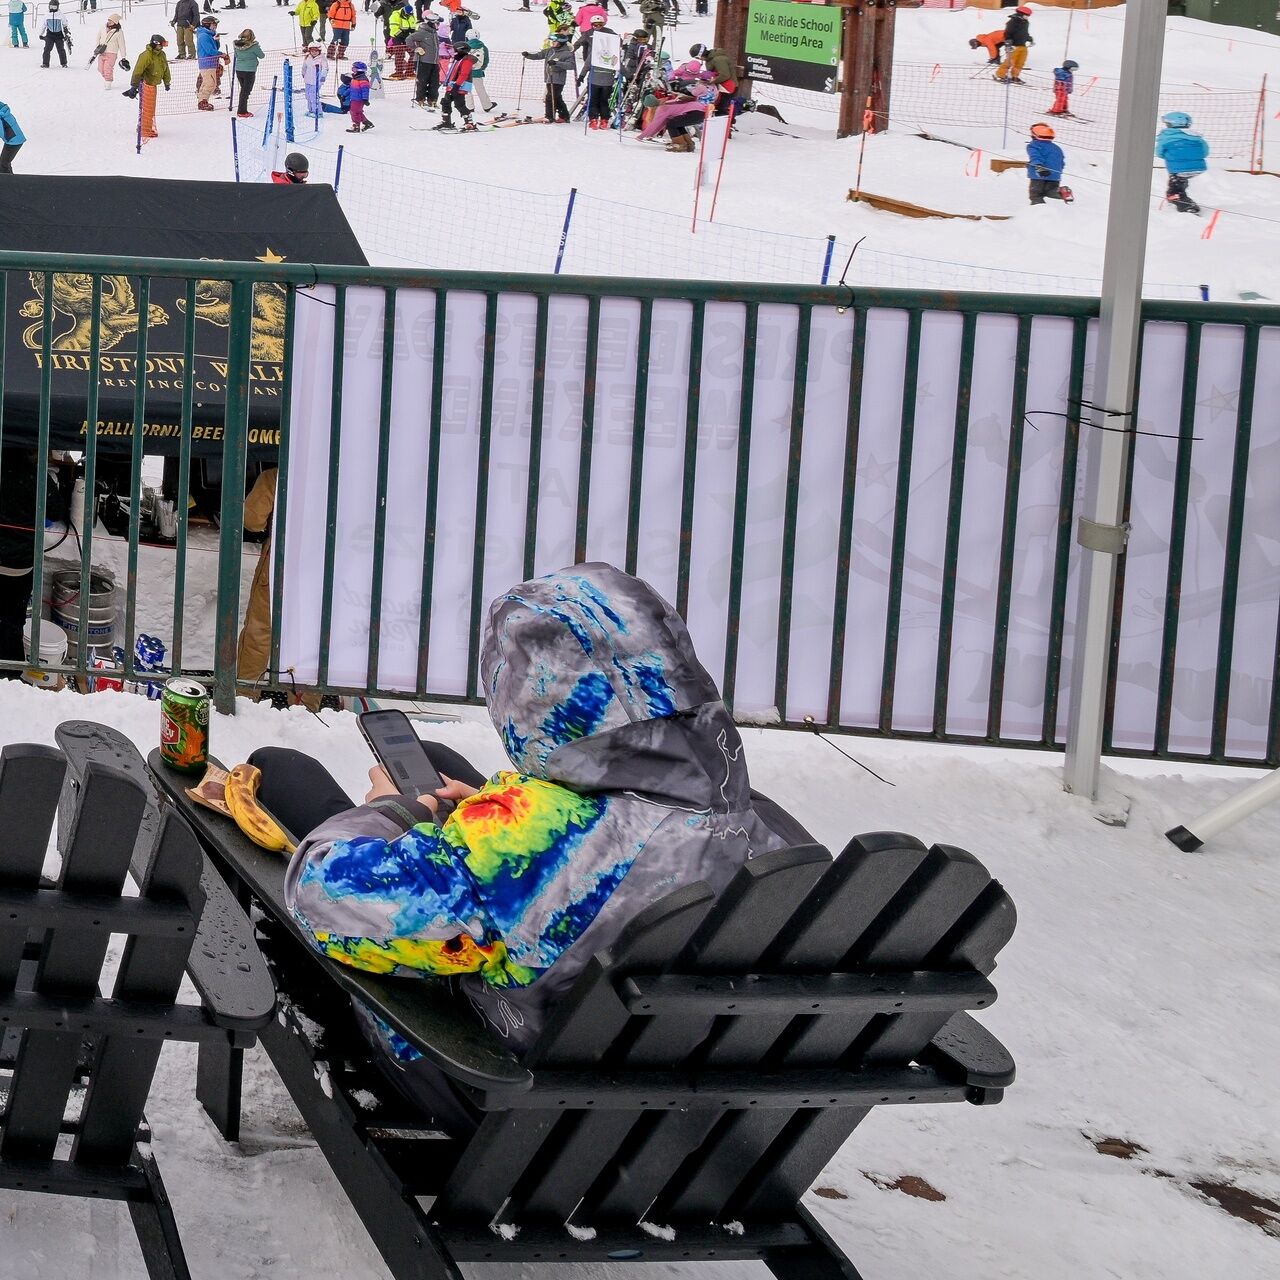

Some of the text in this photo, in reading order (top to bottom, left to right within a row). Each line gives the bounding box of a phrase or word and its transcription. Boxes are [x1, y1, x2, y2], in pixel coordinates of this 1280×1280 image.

[754, 12, 834, 33] Ski & Ride School
[760, 30, 824, 49] Meeting Area
[192, 426, 225, 441] BEE
